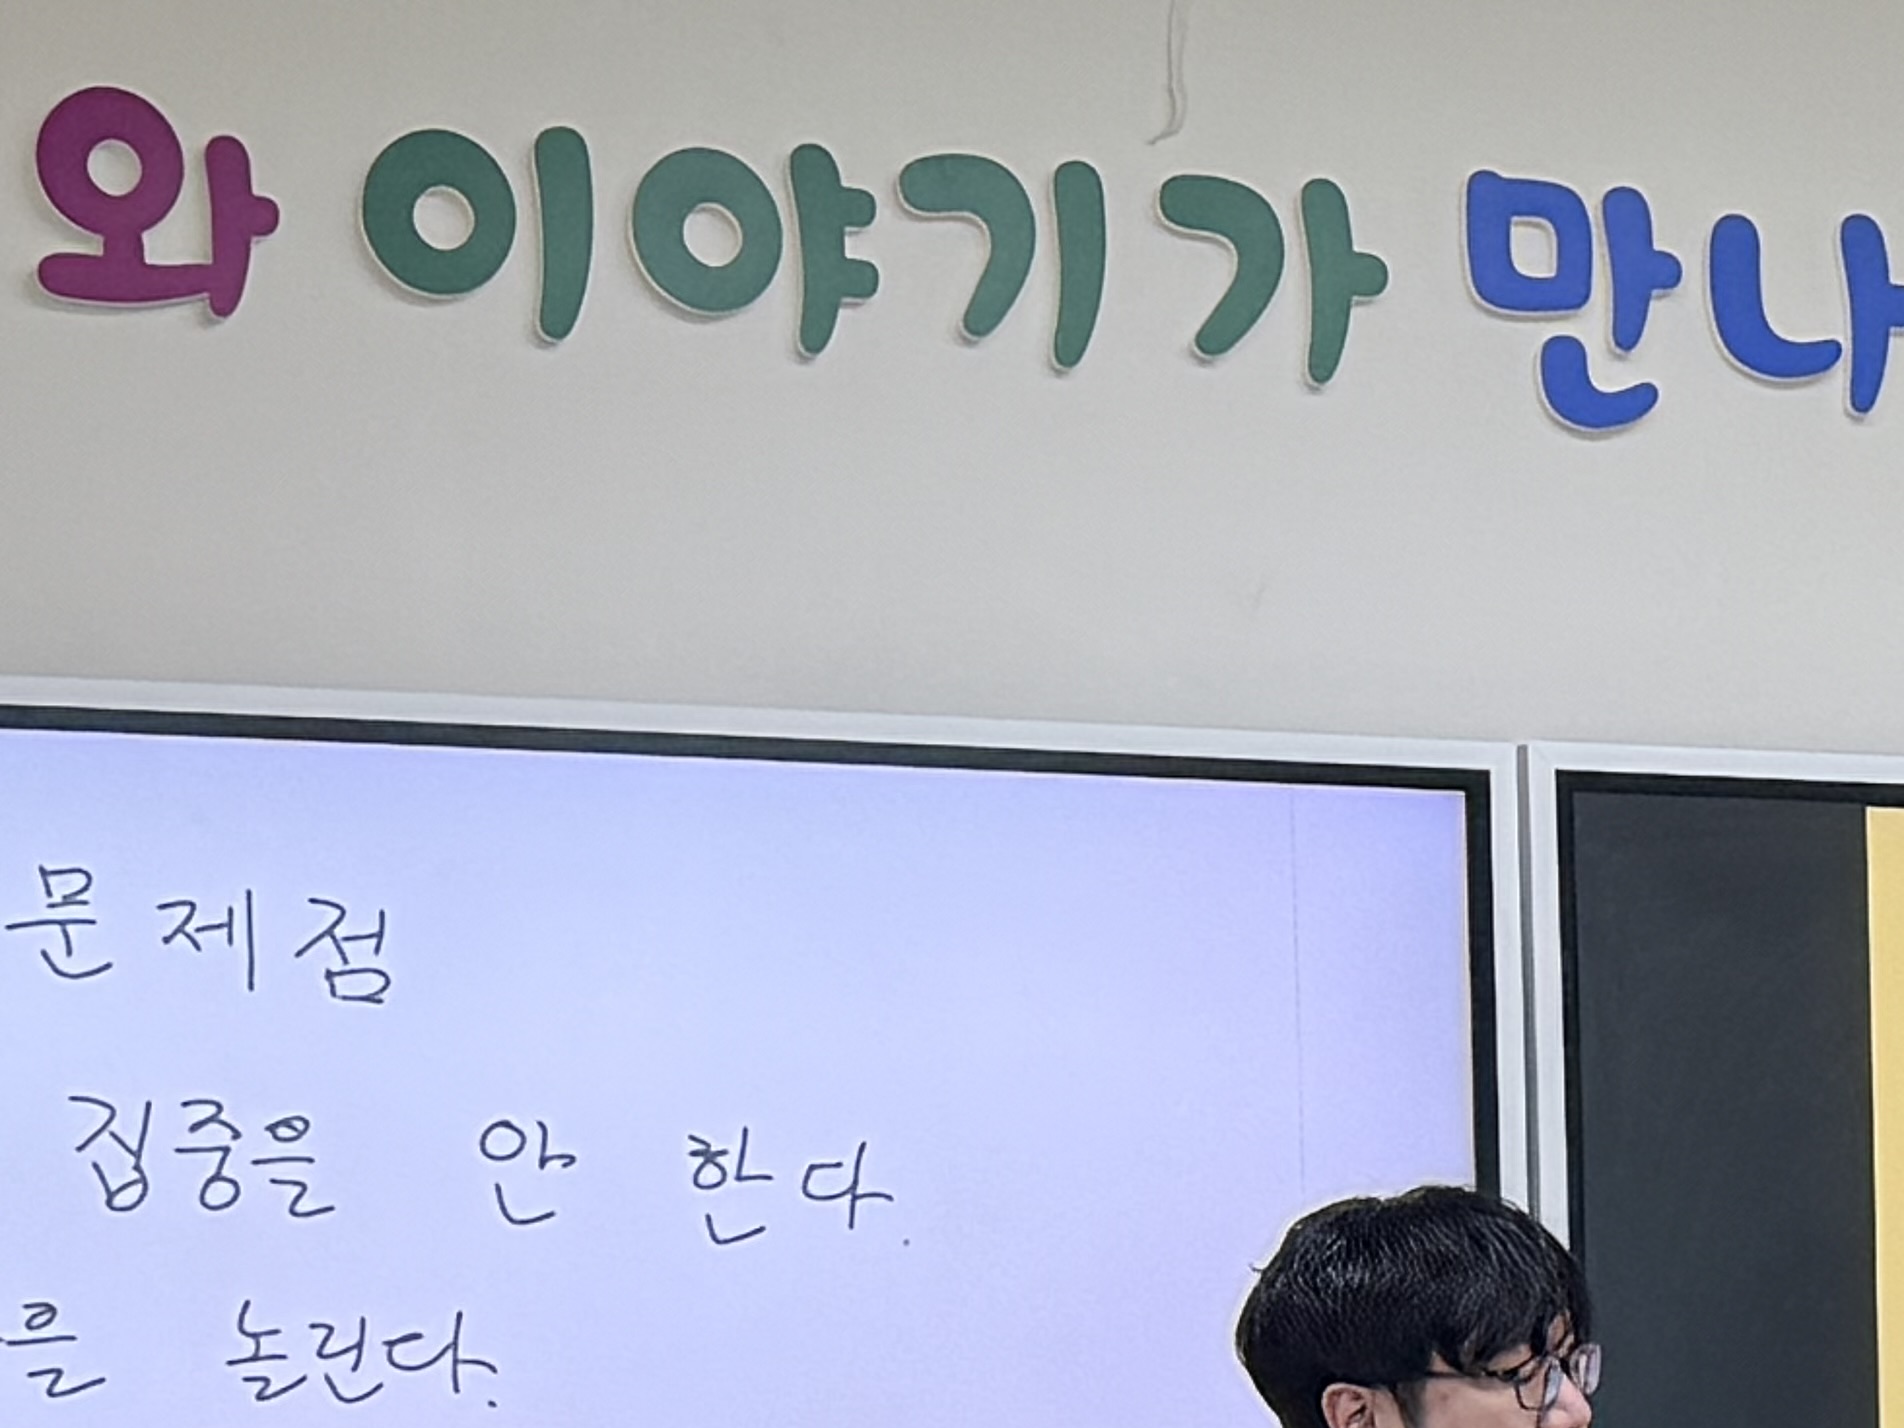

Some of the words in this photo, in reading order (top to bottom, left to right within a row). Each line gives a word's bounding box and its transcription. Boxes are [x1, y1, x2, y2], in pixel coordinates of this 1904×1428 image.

[33, 84, 281, 323] 와
[358, 124, 1390, 392] 이야기가
[3, 863, 394, 1006] 문제점
[66, 1094, 338, 1219] 집중을
[478, 1118, 578, 1227] 안
[686, 1124, 911, 1247] 한다.
[224, 1298, 499, 1409] 놀린다.
